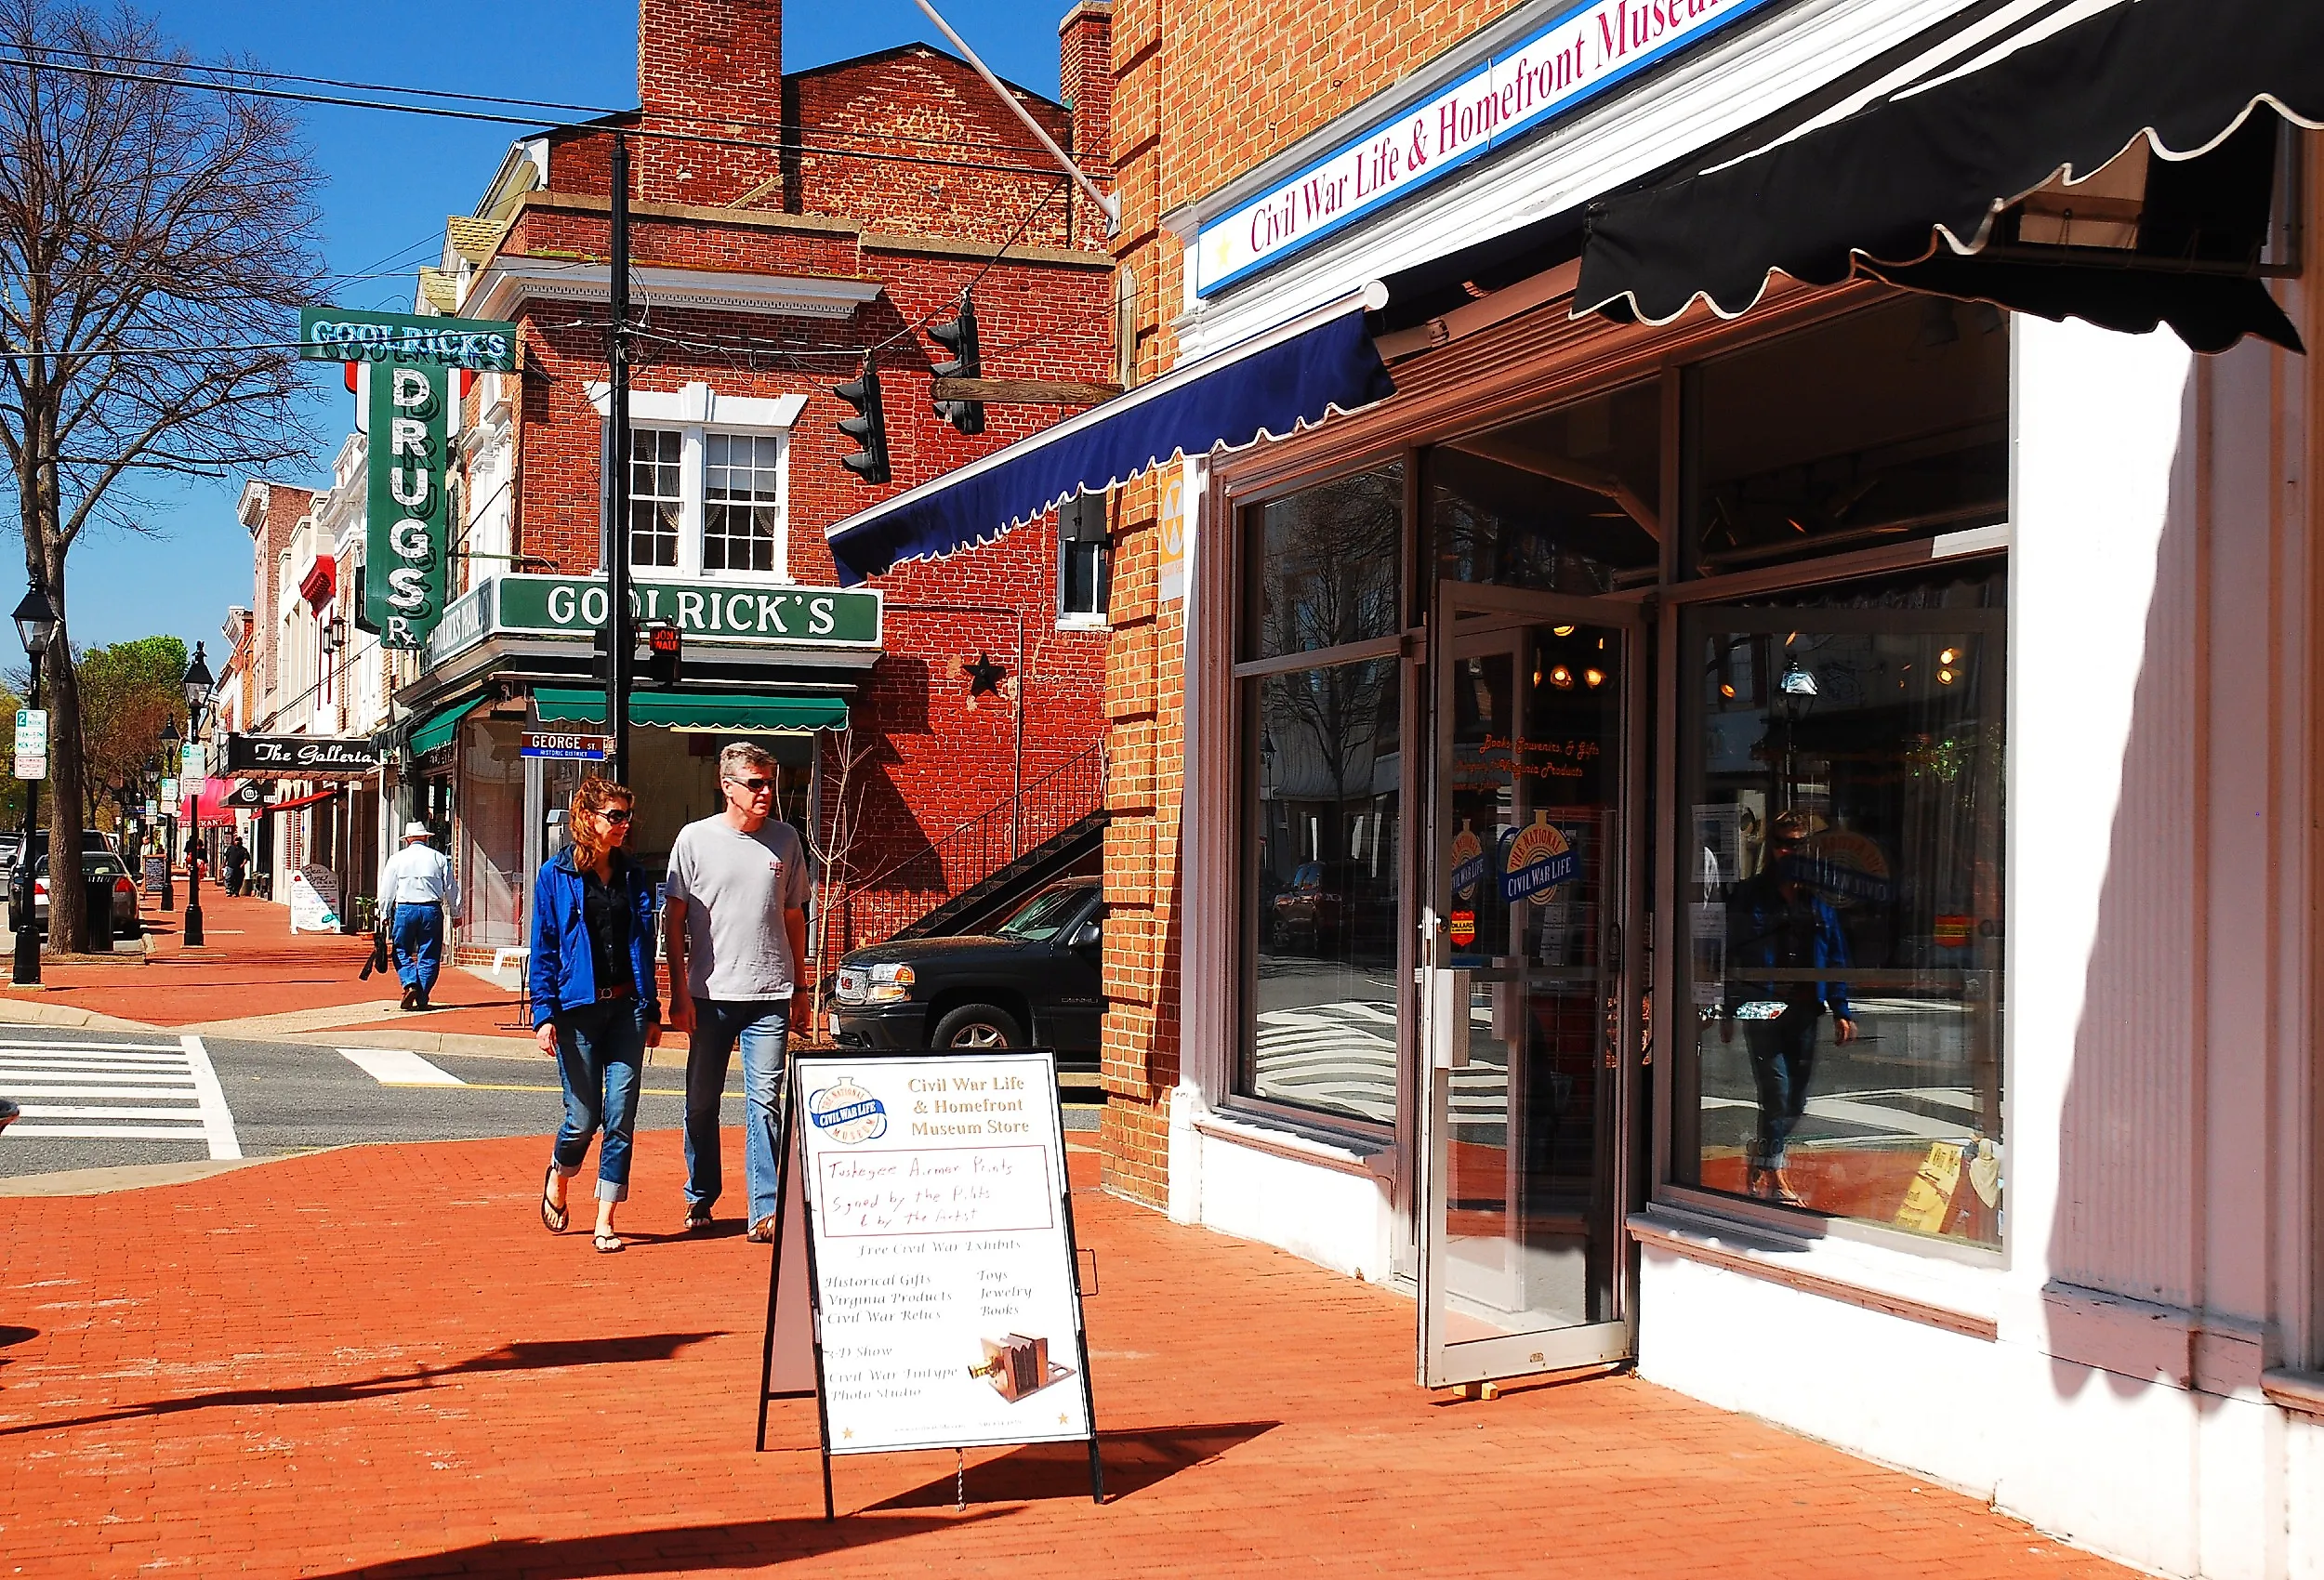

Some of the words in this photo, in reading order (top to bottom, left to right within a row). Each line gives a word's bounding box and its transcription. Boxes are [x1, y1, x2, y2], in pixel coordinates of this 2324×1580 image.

[1250, 191, 1296, 253] Civil
[1303, 173, 1348, 226] War
[1355, 137, 1399, 201] Life
[1407, 118, 1429, 171] &
[1437, 30, 1585, 157] Homefront
[311, 320, 508, 359] GOOLRICK'S
[385, 367, 430, 607] DRUGS
[532, 735, 582, 749] GEORGE
[254, 743, 292, 760] The
[297, 744, 374, 766] Galleria
[1540, 761, 1583, 779] Products
[1511, 844, 1525, 868] THE
[1523, 827, 1562, 853] NATIONAL
[1508, 874, 1532, 897] CIVIL
[1532, 865, 1550, 888] WAR
[1552, 857, 1571, 879] LIFE
[908, 1078, 946, 1092] Civil
[952, 1078, 987, 1091] War
[993, 1076, 1024, 1090] Life
[819, 1111, 841, 1126] CIVIL
[839, 1106, 858, 1121] WAR
[857, 1101, 877, 1116] LIFE
[913, 1099, 928, 1114] &
[934, 1099, 1023, 1113] Homefront
[832, 1118, 876, 1140] MUSEUM
[912, 1122, 983, 1136] Museum
[987, 1119, 1029, 1134] Store
[829, 1160, 897, 1180] Tuskegee
[890, 1191, 905, 1212] by
[916, 1188, 941, 1203] the
[878, 1215, 893, 1228] by
[904, 1212, 927, 1225] the
[935, 1208, 978, 1223] Artist
[892, 1242, 925, 1255] Civil
[932, 1242, 958, 1252] War
[965, 1240, 1021, 1251] Exhibits
[825, 1275, 896, 1288] Historical
[900, 1273, 931, 1288] Gifts
[977, 1270, 1008, 1283] Toys
[826, 1293, 886, 1309] Virginia
[891, 1290, 953, 1304] Products
[980, 1286, 1032, 1299] Jewelry
[827, 1311, 862, 1324] Civil
[866, 1310, 896, 1323] War
[901, 1310, 941, 1321] Relics
[980, 1304, 1020, 1317] Books
[857, 1346, 893, 1359] Show
[829, 1371, 864, 1384] Civil
[867, 1369, 899, 1381] War
[831, 1389, 872, 1402] Photo
[877, 1388, 922, 1400] Studio
